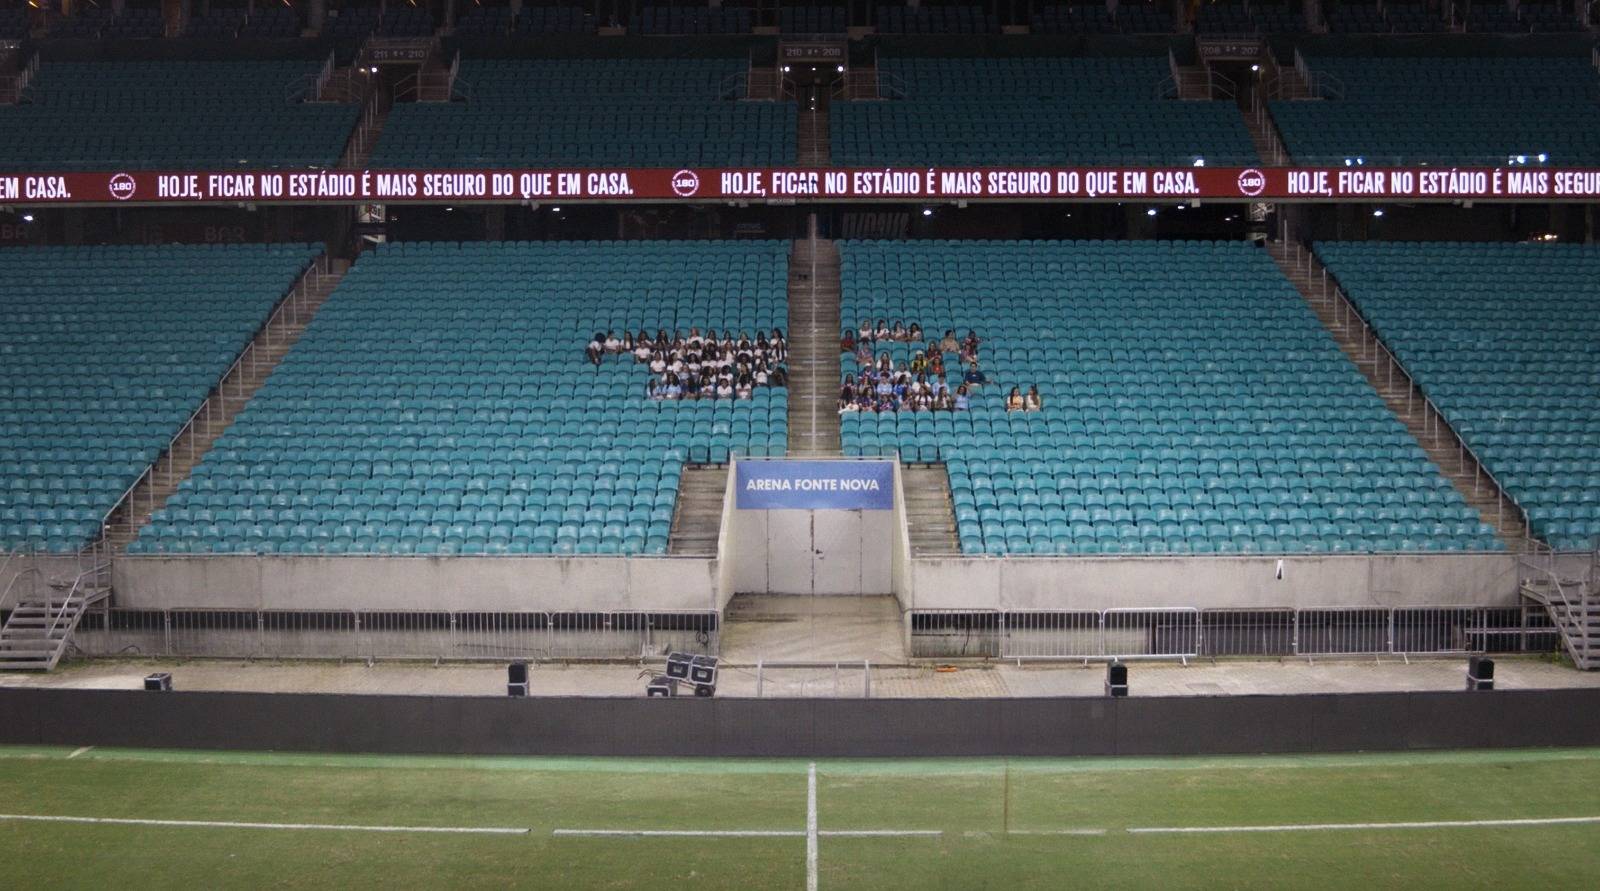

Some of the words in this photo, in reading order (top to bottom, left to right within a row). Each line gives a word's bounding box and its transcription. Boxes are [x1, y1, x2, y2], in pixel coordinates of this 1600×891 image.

[1242, 47, 1258, 55] 207
[26, 177, 71, 199] CASA.
[113, 183, 132, 191] 180
[158, 175, 203, 200] HOJE,
[209, 174, 255, 197] FICAR
[261, 174, 282, 197] NO
[290, 169, 356, 197] ESTÁDIO
[362, 169, 371, 195] É
[376, 174, 417, 196] MAIS
[423, 173, 486, 196] SEGURO
[493, 173, 514, 195] DO
[520, 173, 552, 198] QUE
[557, 173, 581, 195] EM
[587, 172, 634, 195] CASA.
[675, 179, 695, 187] 180
[721, 172, 766, 197] HOJE,
[772, 171, 819, 194] FICAR
[825, 172, 847, 194] NO
[854, 168, 919, 194] ESTÁDIO
[926, 168, 936, 194] É
[941, 172, 982, 194] MAIS
[987, 171, 1051, 194] SEGURO
[1057, 172, 1079, 194] DO
[1085, 172, 1118, 198] QUE
[1124, 172, 1147, 194] EM
[1153, 171, 1200, 194] CASA.
[1241, 178, 1261, 187] 180
[1287, 172, 1333, 197] HOJE,
[1338, 172, 1385, 194] FICAR
[1391, 171, 1413, 194] NO
[1420, 168, 1486, 194] ESTÁDIO
[1493, 168, 1502, 194] É
[1508, 172, 1548, 194] MAIS
[746, 479, 791, 491] ARENA
[795, 479, 837, 491] FONTE
[840, 479, 880, 491] NOVA
